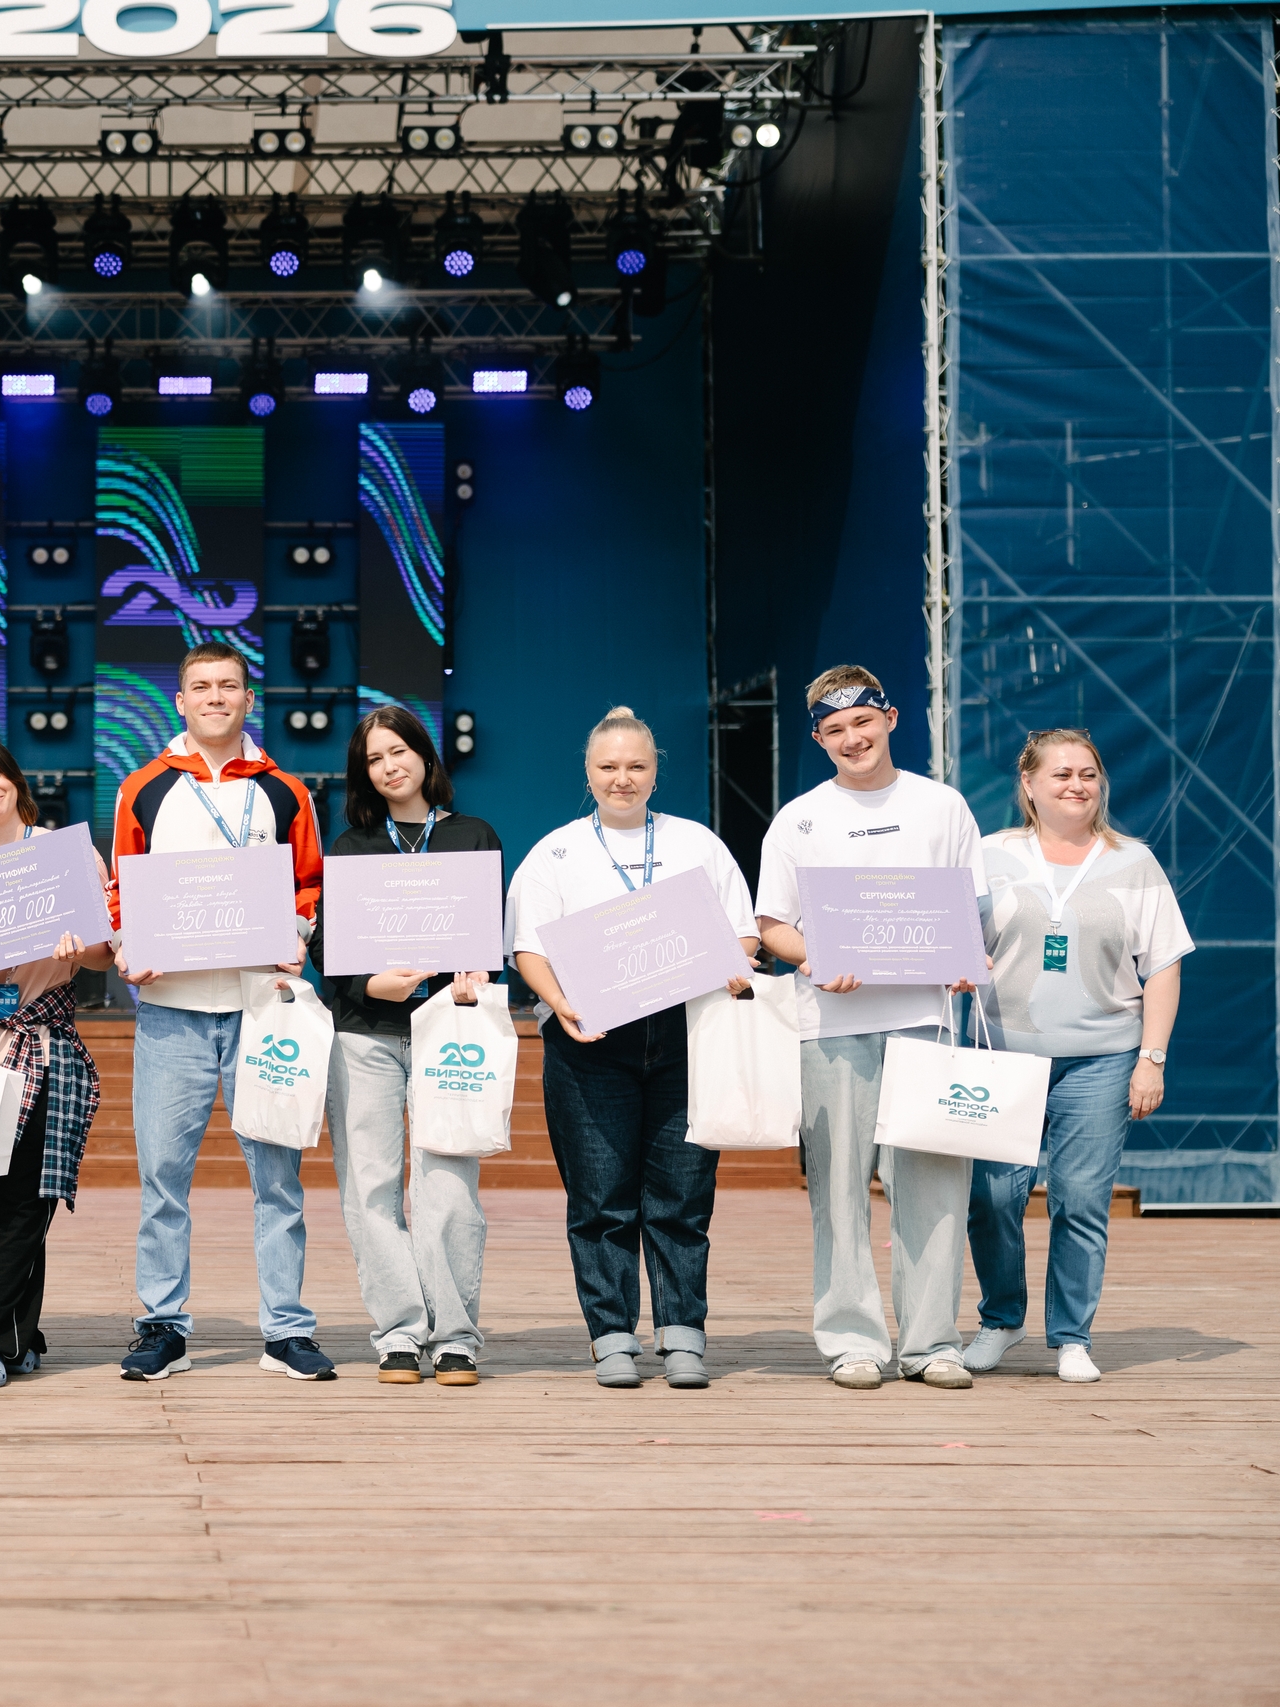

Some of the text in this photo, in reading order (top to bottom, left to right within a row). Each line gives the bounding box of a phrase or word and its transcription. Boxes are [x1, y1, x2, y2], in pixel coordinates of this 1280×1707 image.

[179, 874, 234, 885] СЕРТИФИКАТ
[385, 879, 440, 888] СЕРТИФИКАТ
[860, 892, 916, 900] СЕРТИФИКАТ
[26, 894, 56, 920] 000
[173, 907, 245, 931] 350 000
[378, 913, 455, 933] 400 000
[604, 911, 658, 936] СЕРТИФИКАТ
[863, 925, 936, 945] 630 000
[614, 949, 648, 984] 500
[656, 935, 688, 968] 000
[438, 1080, 483, 1092] 2026
[937, 1098, 999, 1114] БИРЮСА
[949, 1108, 987, 1120] 2026
